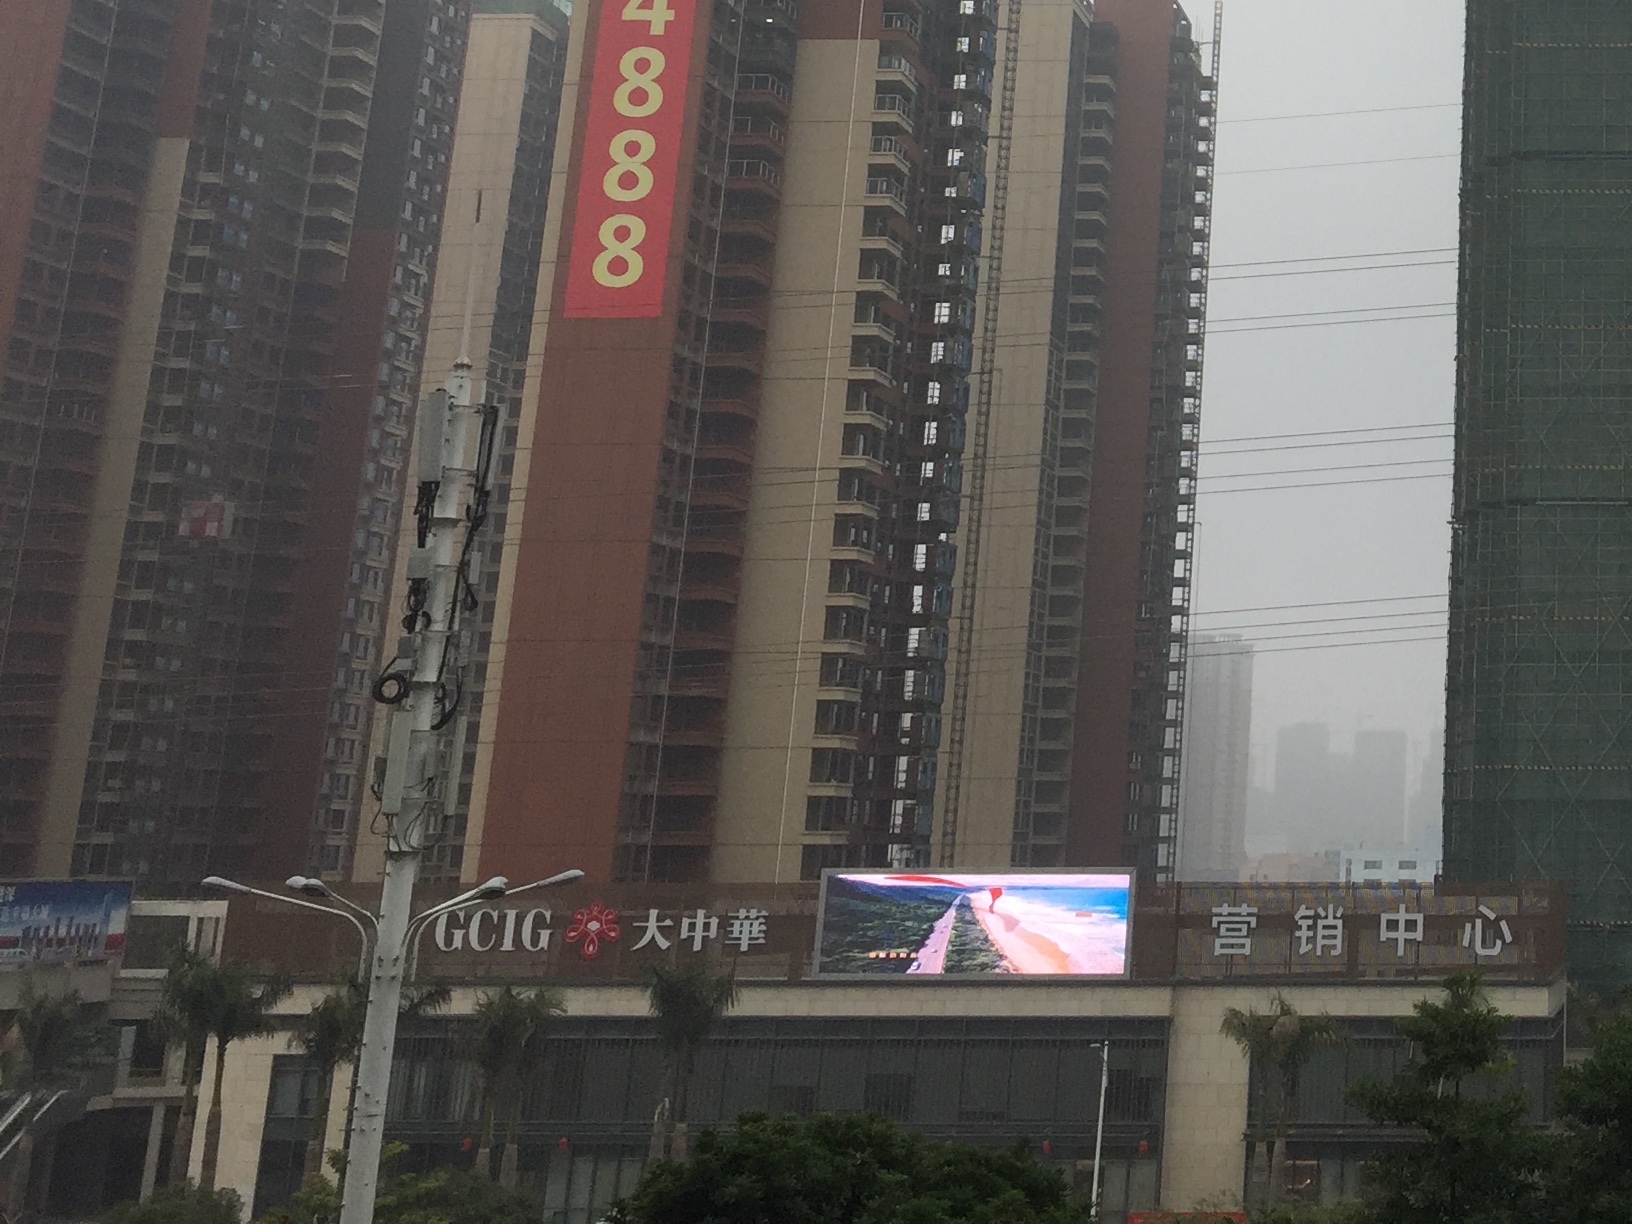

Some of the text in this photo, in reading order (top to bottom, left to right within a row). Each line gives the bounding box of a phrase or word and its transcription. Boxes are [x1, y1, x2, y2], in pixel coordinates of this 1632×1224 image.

[435, 909, 553, 951] GCIG
[630, 908, 769, 952] 大中華
[1211, 903, 1512, 958] 营销中心
